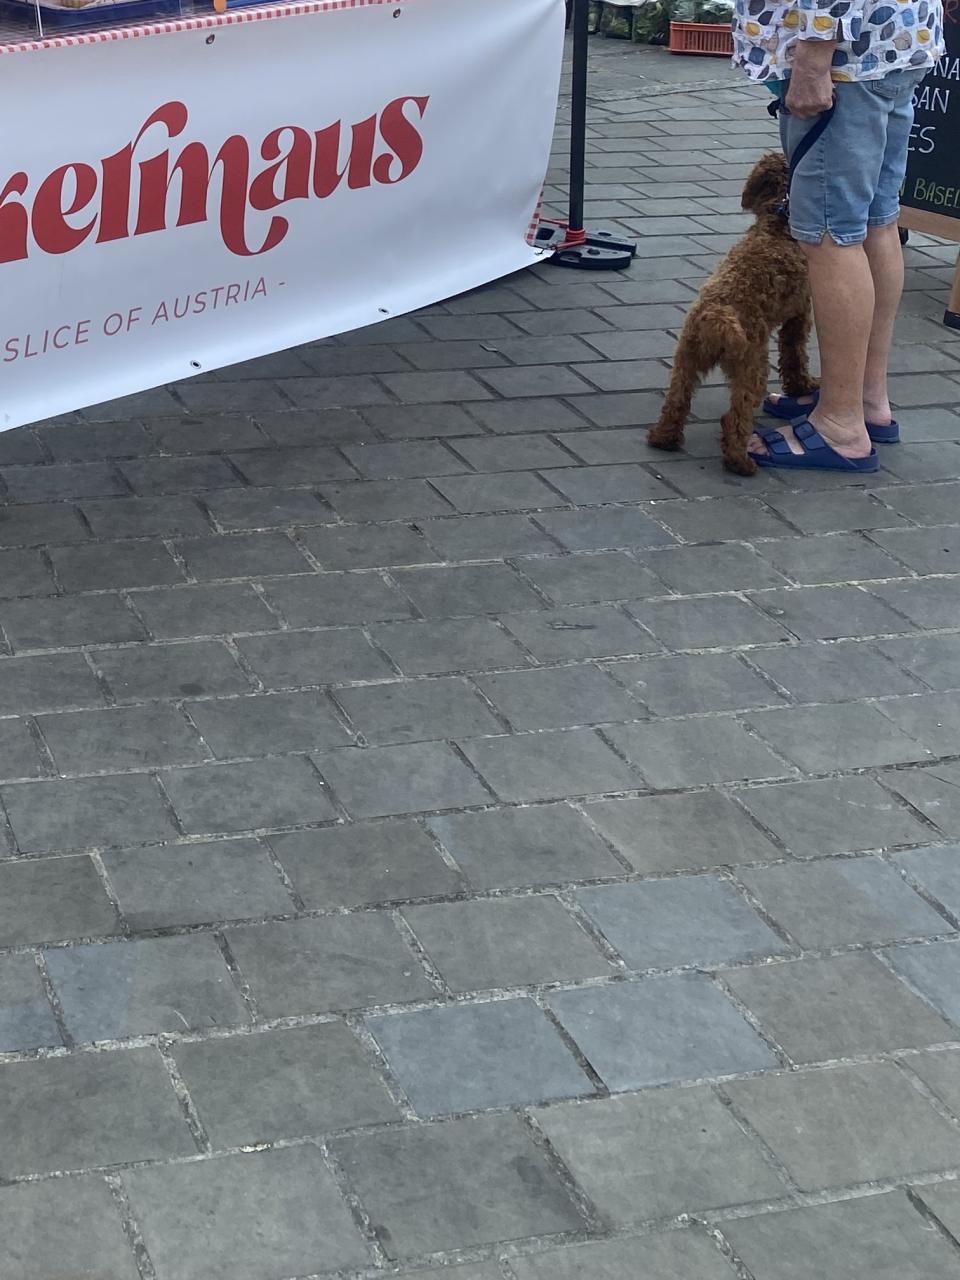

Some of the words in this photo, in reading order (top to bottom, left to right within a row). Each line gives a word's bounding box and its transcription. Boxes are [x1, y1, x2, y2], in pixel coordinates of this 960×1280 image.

[3, 319, 92, 363] SLICE
[103, 307, 143, 337] OF
[151, 276, 268, 326] AUSTRIA
